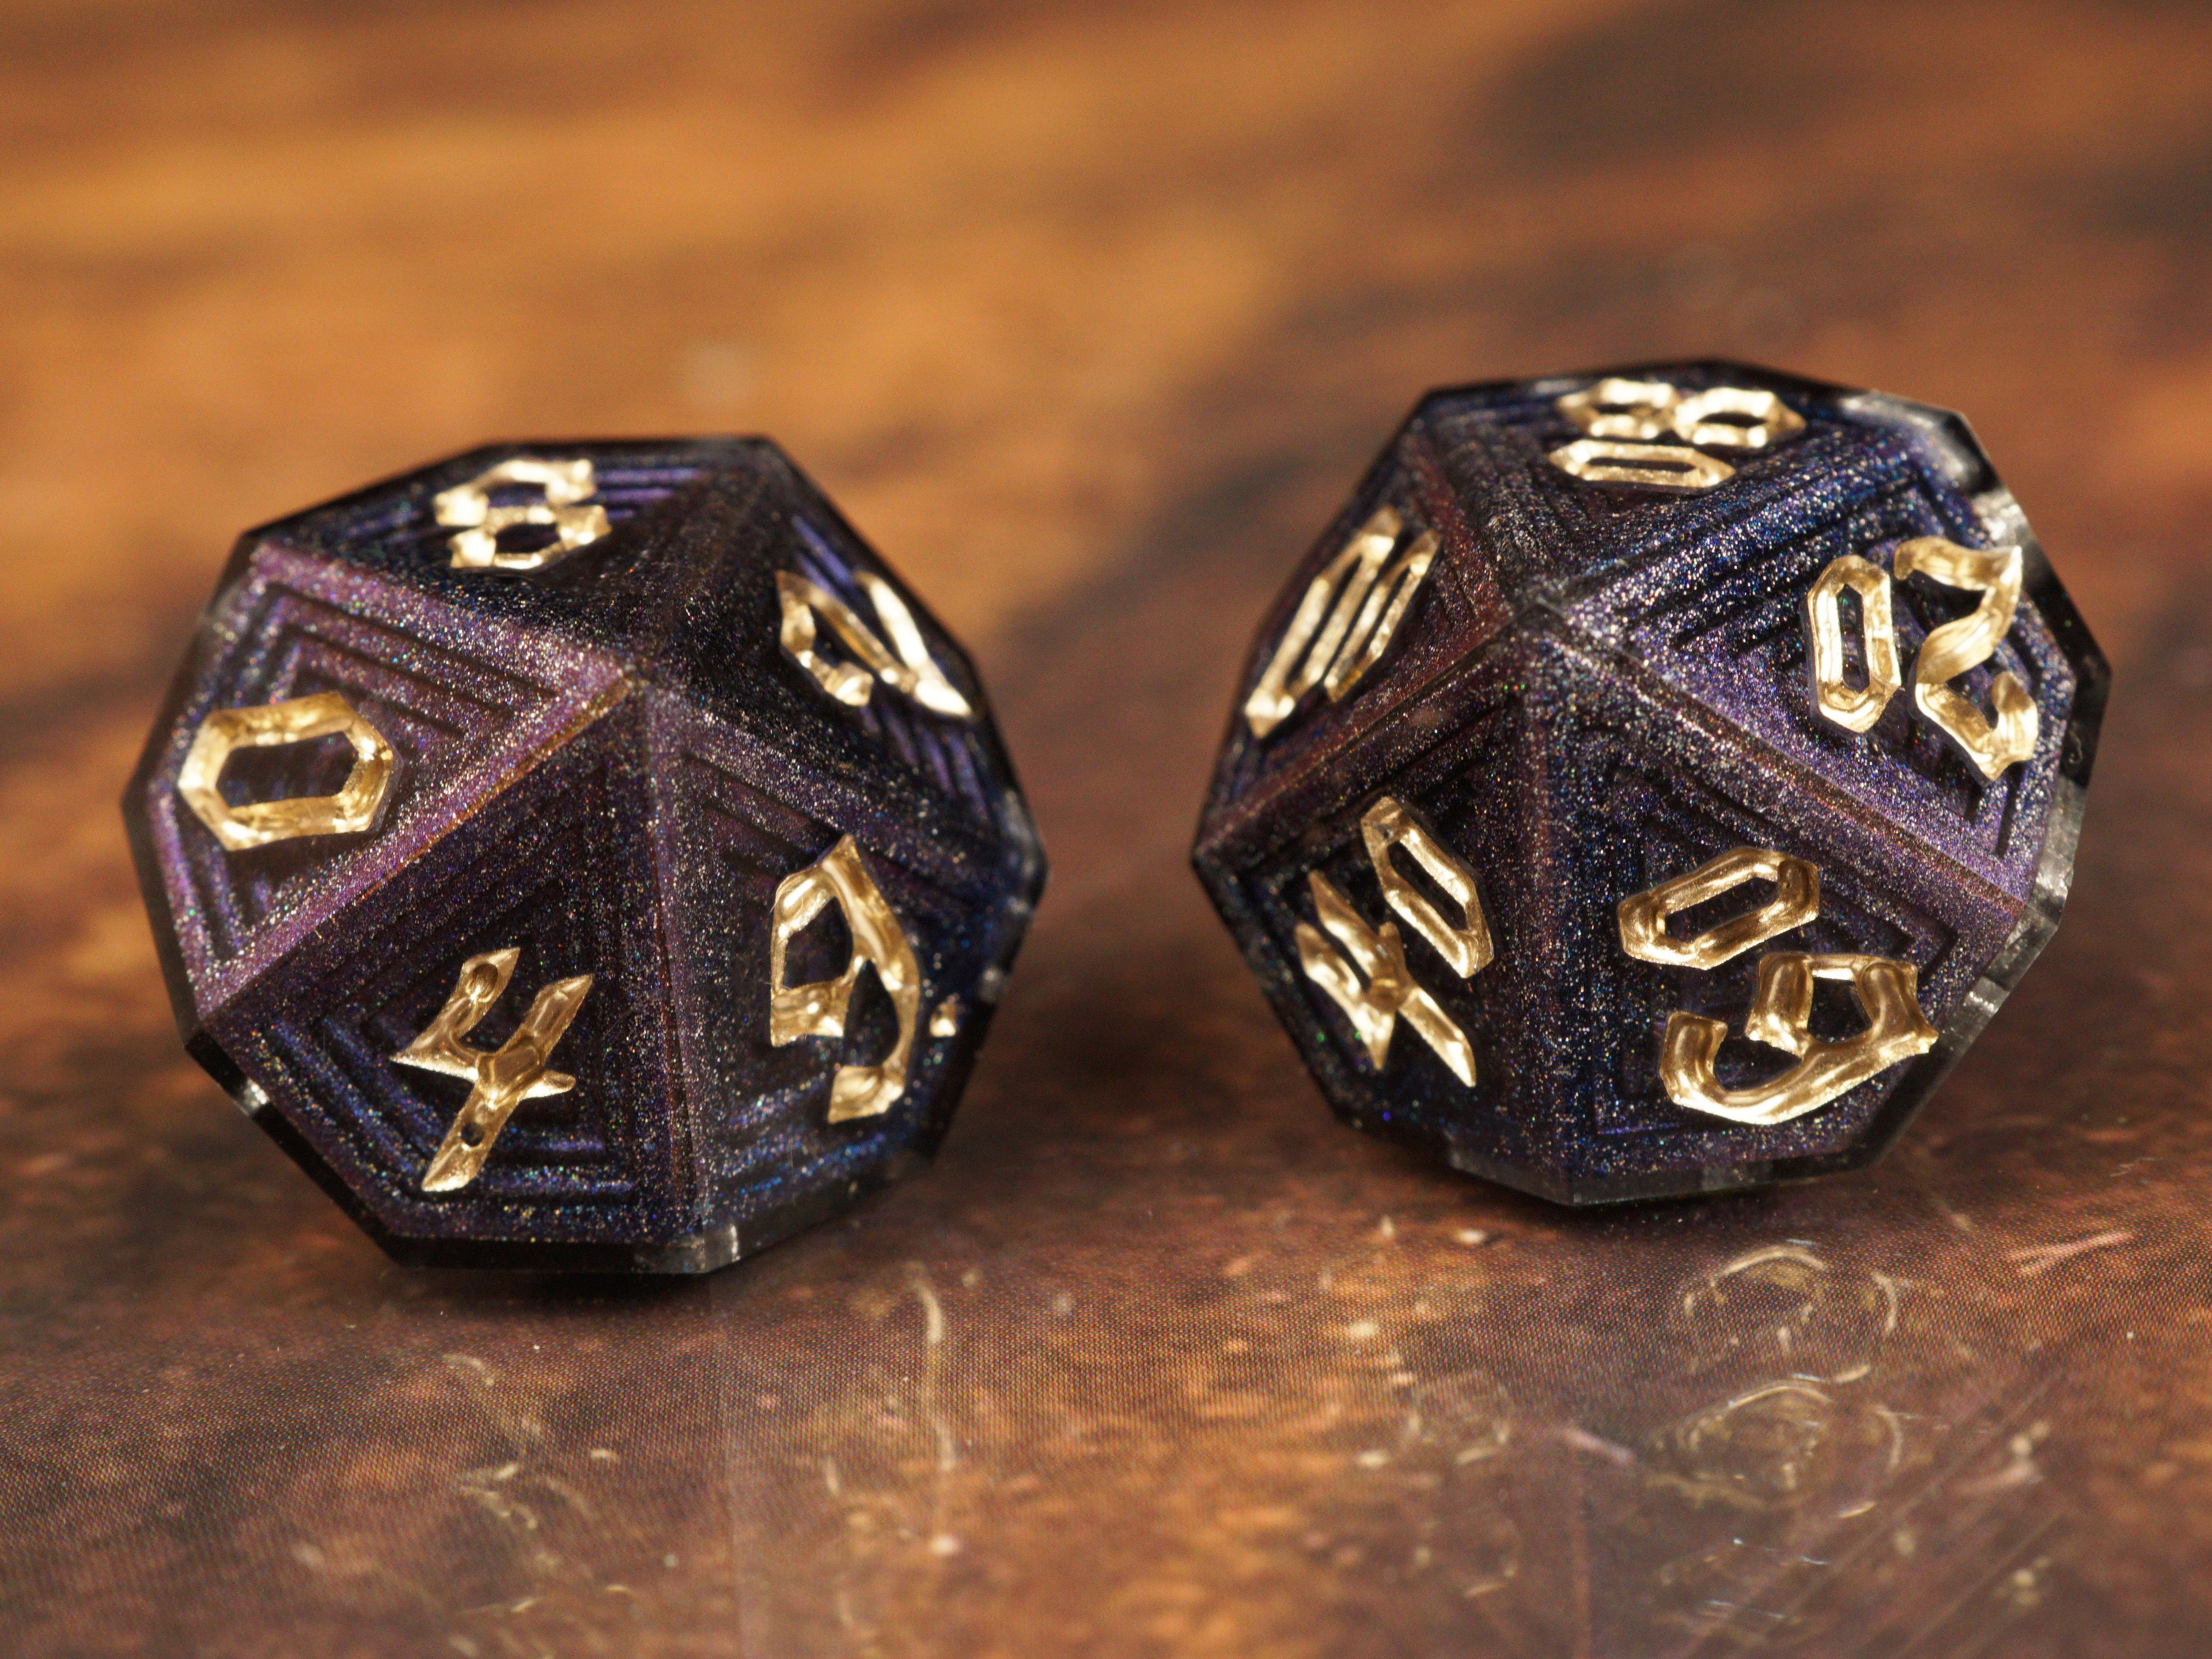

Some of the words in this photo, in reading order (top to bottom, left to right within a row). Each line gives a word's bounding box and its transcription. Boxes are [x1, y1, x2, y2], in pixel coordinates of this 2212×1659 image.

[433, 458, 613, 570] 8
[776, 570, 974, 718] 2
[177, 691, 399, 853] 0
[390, 946, 593, 1192] 4
